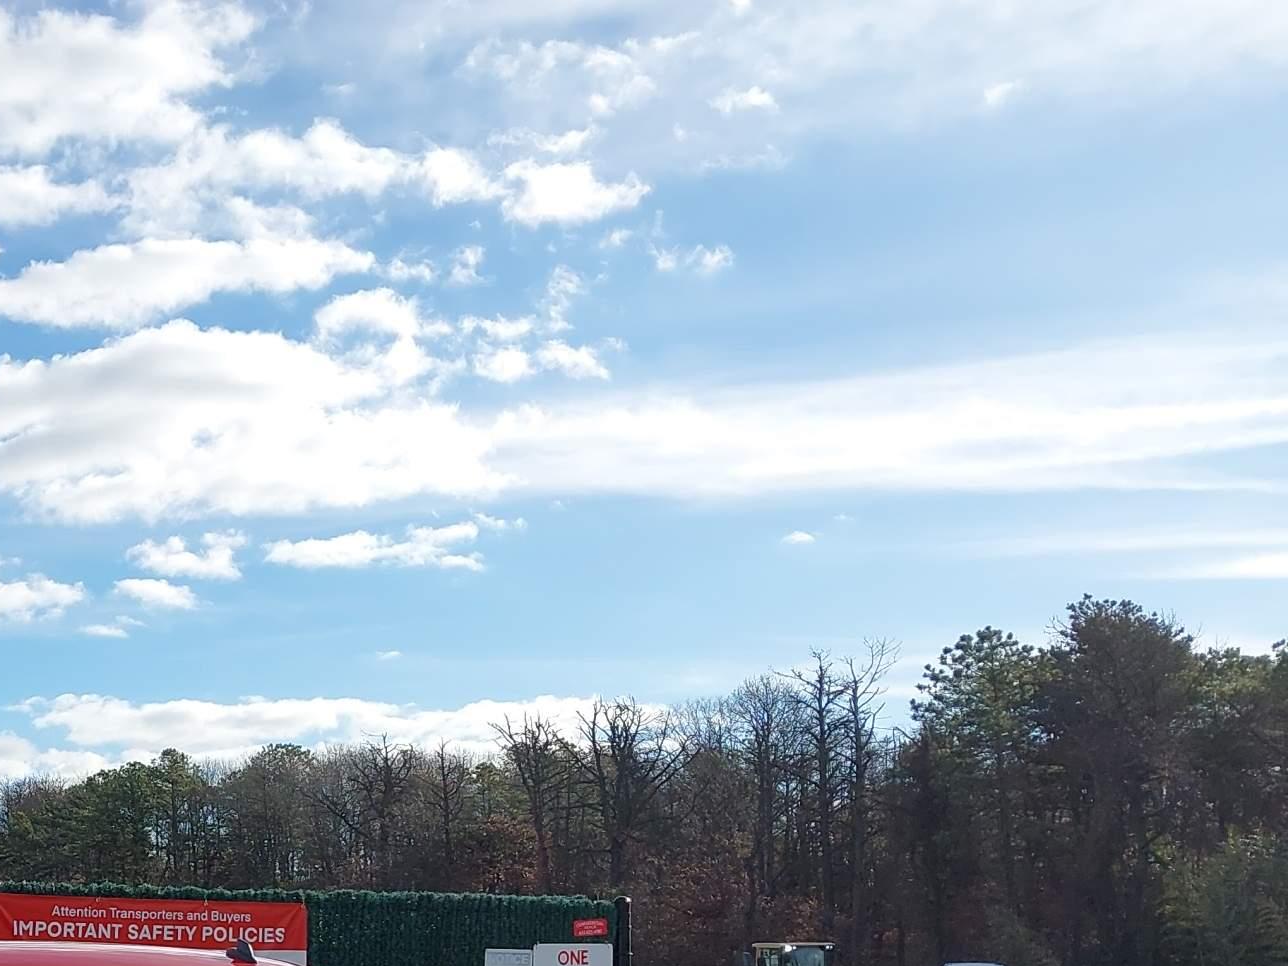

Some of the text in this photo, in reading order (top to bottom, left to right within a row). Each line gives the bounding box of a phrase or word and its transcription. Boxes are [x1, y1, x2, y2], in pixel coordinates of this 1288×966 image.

[51, 905, 252, 923] Attention Transporters and Buyers
[13, 920, 286, 944] IMPORTANT SAFETY POLICIES
[557, 950, 589, 965] ONE
